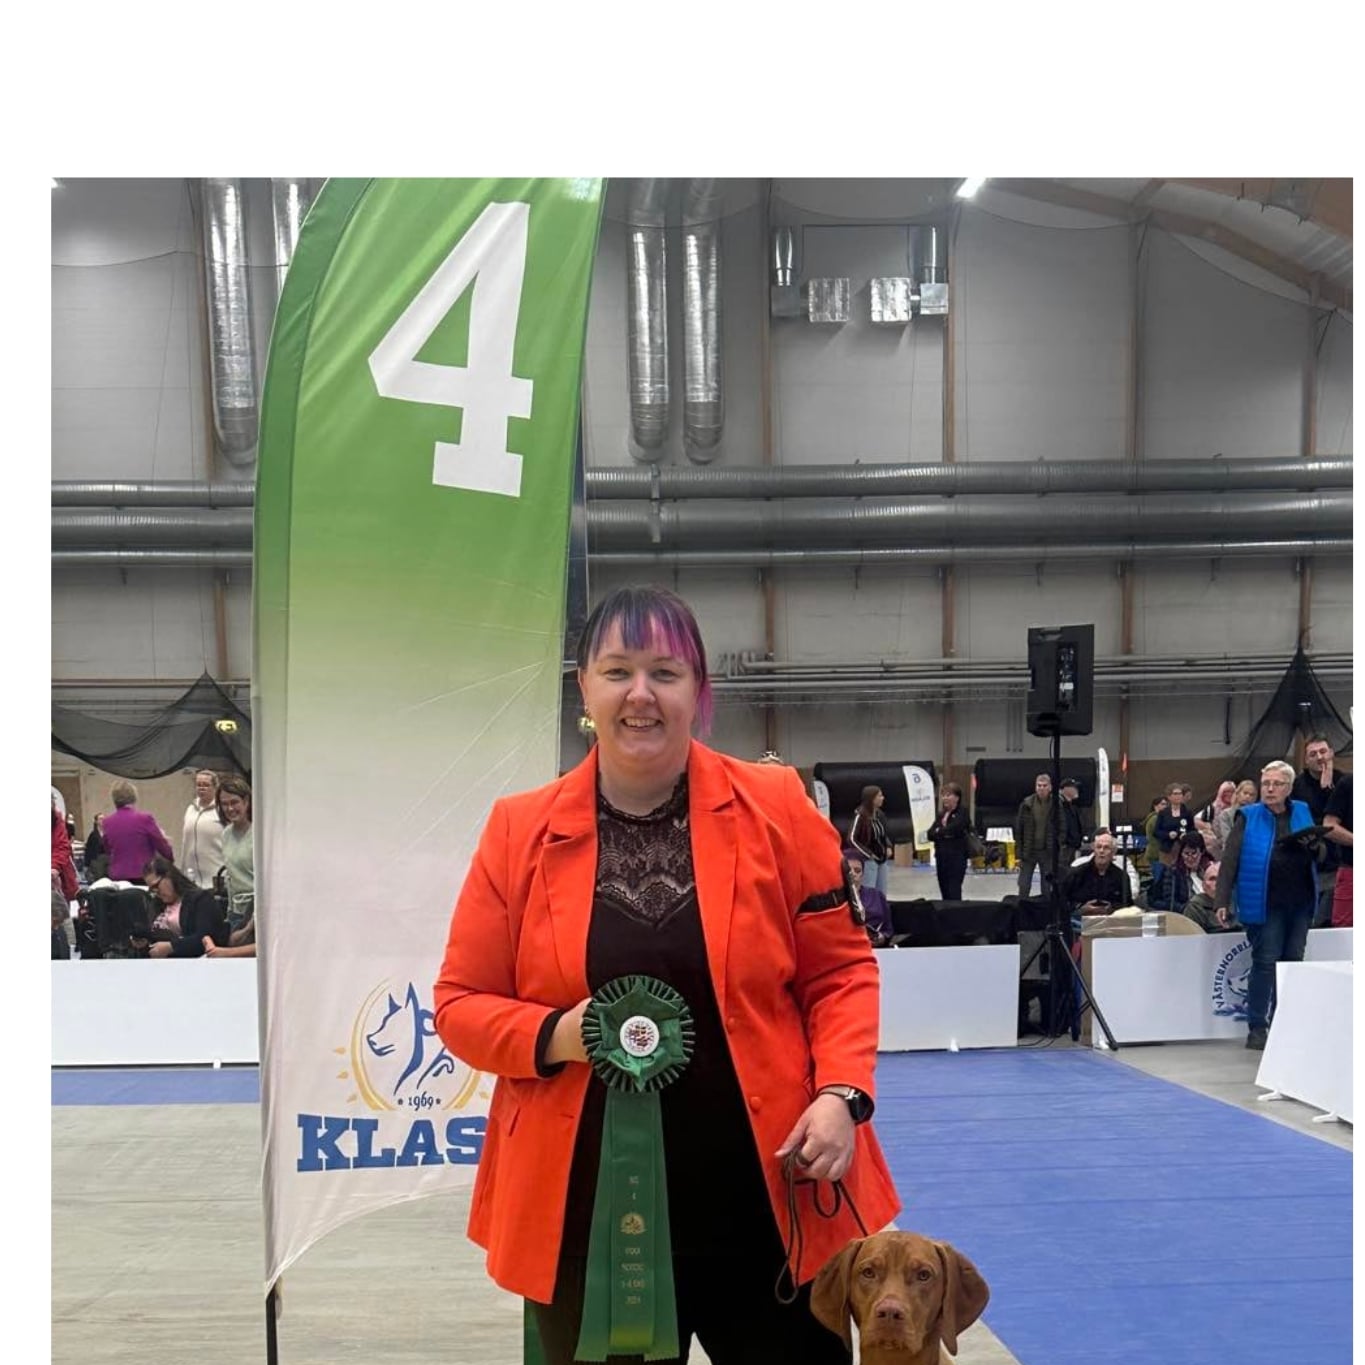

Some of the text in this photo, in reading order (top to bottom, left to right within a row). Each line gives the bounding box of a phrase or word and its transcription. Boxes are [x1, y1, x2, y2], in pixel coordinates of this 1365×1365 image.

[368, 201, 533, 498] 4
[1212, 940, 1253, 1009] VÄSTERNORRL
[408, 1092, 434, 1112] 1969
[297, 1113, 488, 1173] KLAS
